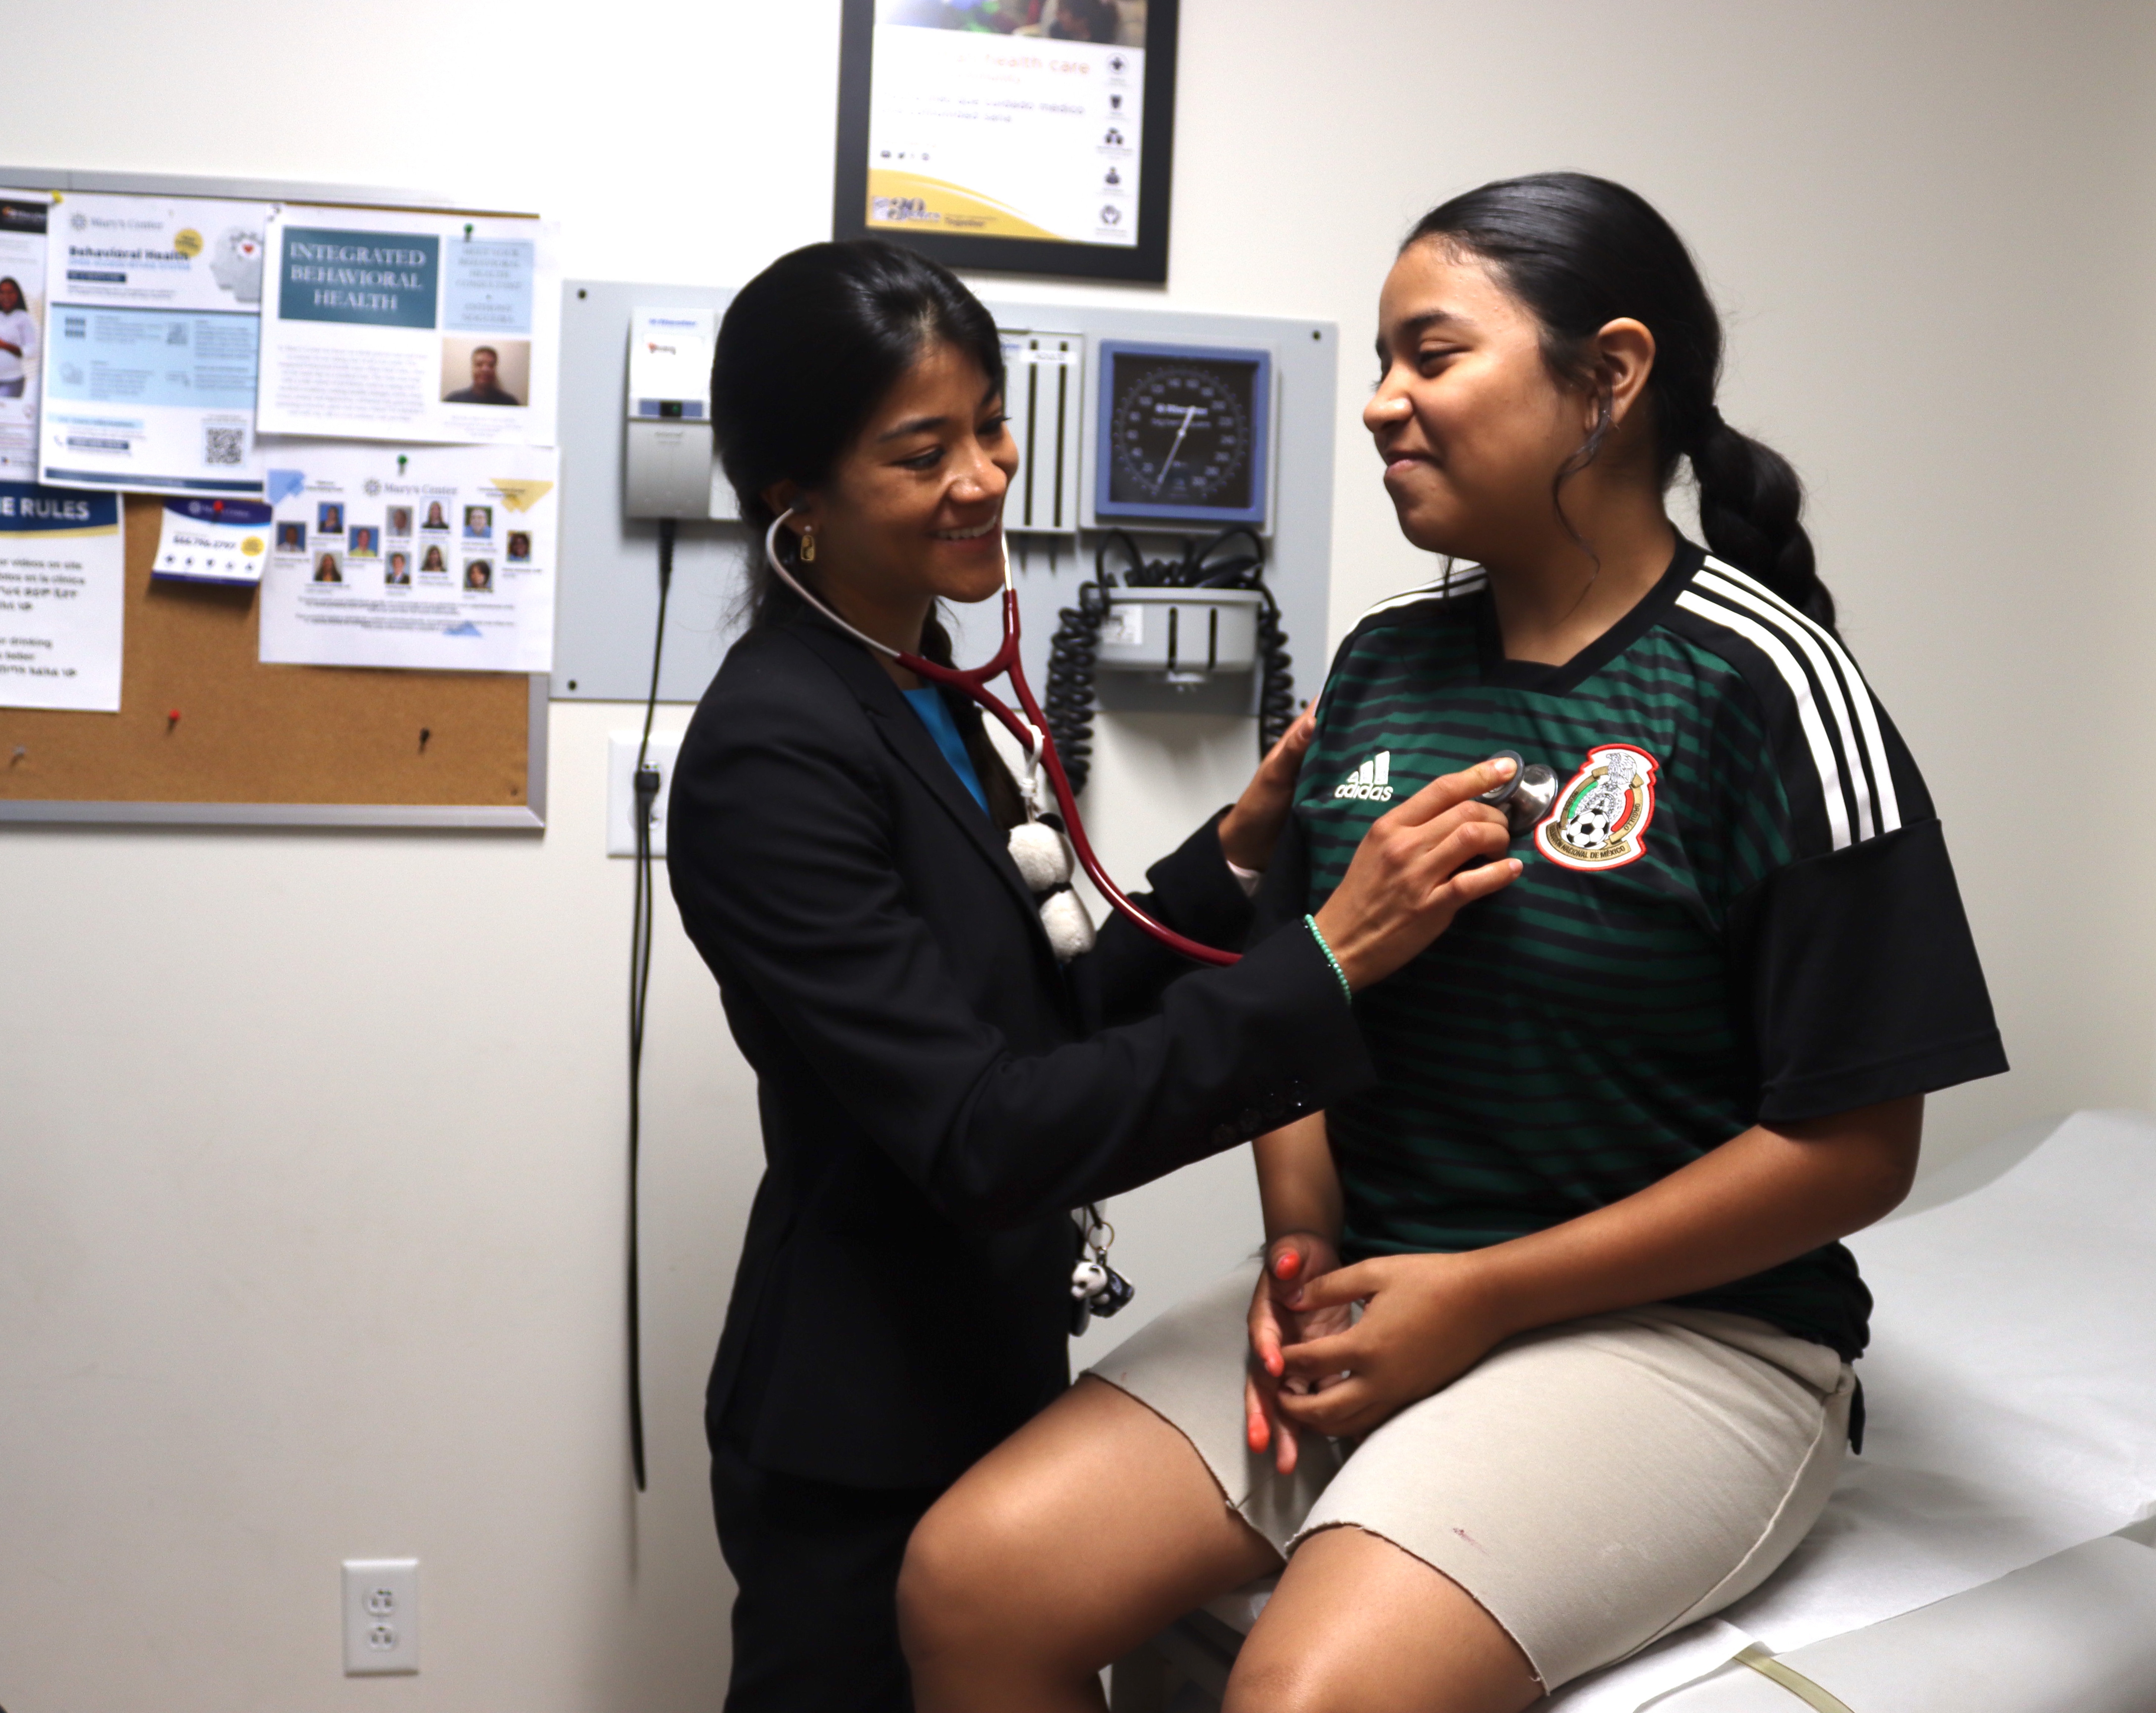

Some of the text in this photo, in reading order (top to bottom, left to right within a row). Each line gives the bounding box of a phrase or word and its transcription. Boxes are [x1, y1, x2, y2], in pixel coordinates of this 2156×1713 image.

[1050, 58, 1090, 75] care
[69, 245, 190, 261] Behavioral Health
[290, 241, 426, 267] INTEGRATED
[291, 264, 423, 291] BEHAVIORAL
[314, 290, 398, 311] HEALTH
[384, 482, 459, 496] Mary's Center
[20, 498, 90, 521] RULES
[1334, 782, 1394, 802] adidas
[1624, 803, 1640, 830] ORGULLO
[1561, 844, 1588, 858] NACIONAL
[1590, 850, 1599, 859] DE
[1600, 845, 1625, 859] MÉXICO
